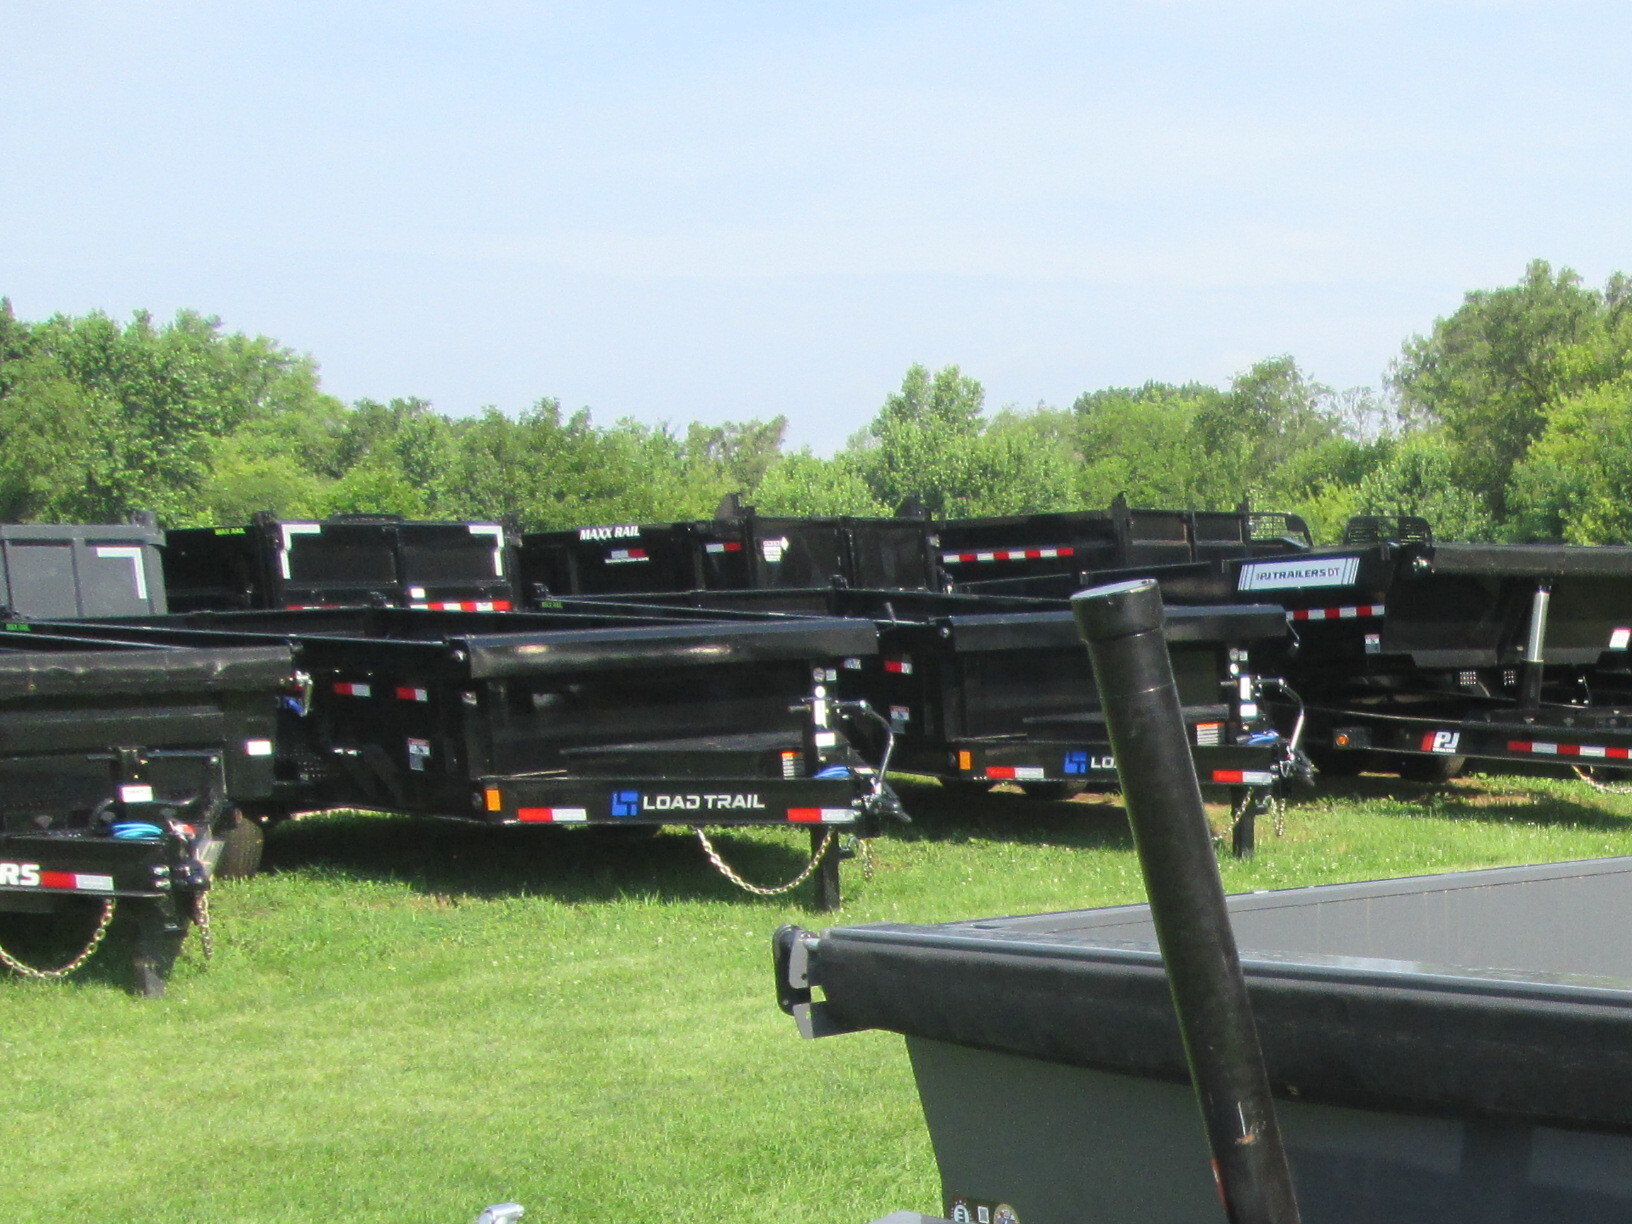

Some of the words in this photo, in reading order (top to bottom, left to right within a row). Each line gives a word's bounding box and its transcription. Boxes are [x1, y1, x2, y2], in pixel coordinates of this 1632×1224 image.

[580, 528, 613, 541] MAXX
[614, 525, 640, 538] RAIL
[1273, 568, 1327, 580] TRAILERS
[1327, 567, 1341, 577] DT
[1433, 731, 1460, 748] PJ
[643, 795, 701, 810] LOAD
[703, 794, 766, 809] TRAIL
